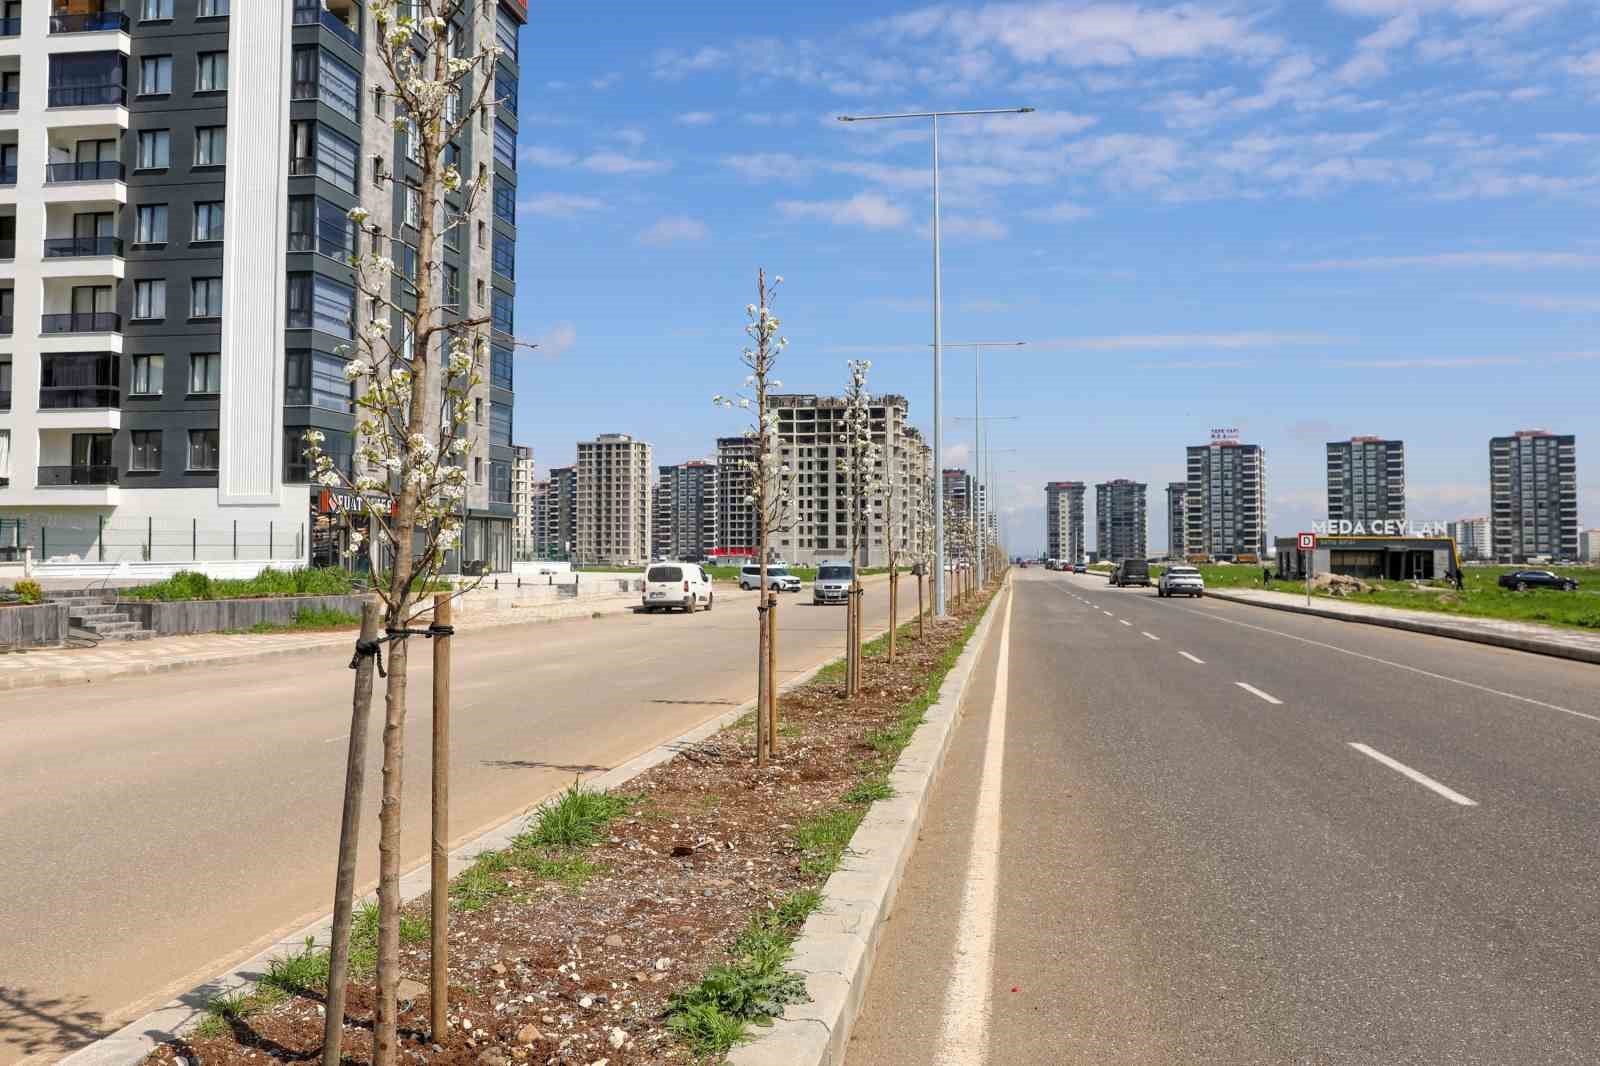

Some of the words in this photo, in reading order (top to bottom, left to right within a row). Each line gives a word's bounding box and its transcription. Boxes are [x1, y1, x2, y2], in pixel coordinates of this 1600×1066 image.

[1312, 519, 1366, 535] MEDA
[1371, 519, 1448, 536] CEYLAN
[1303, 536, 1311, 546] D
